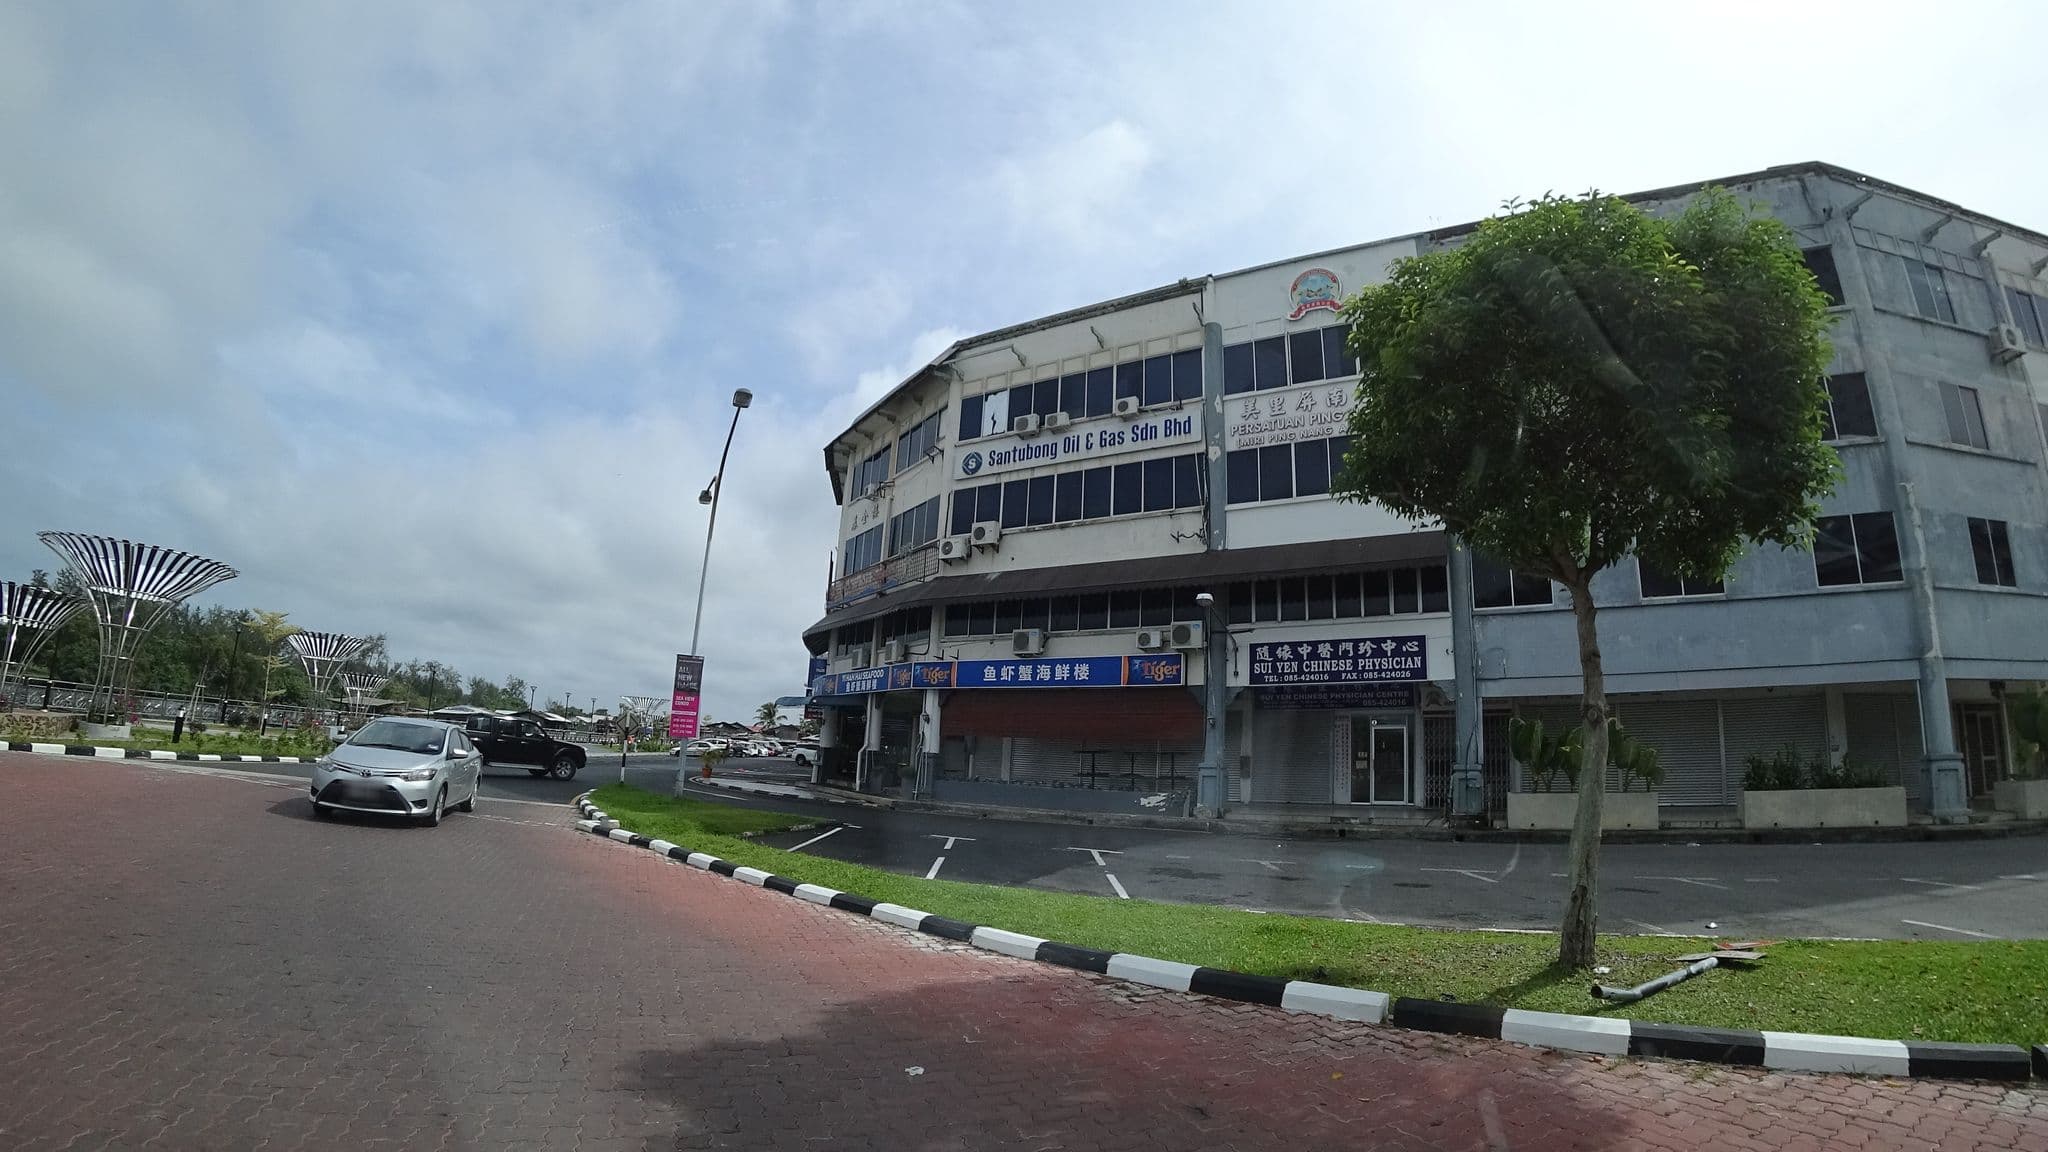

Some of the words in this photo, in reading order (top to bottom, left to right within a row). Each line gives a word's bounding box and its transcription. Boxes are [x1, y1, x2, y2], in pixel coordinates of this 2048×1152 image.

[1231, 416, 1305, 436] PERSATUAN
[1310, 412, 1345, 425] PING
[988, 440, 1058, 467] Santubong
[1063, 434, 1080, 454] Oil
[1100, 430, 1125, 448] Gas
[1131, 423, 1158, 442] Sdn
[1164, 415, 1192, 437] Bhd
[1268, 431, 1296, 443] PING
[1300, 427, 1333, 438] NANG
[863, 669, 885, 679] SEAFOOD
[983, 663, 1090, 682] 鱼虾蟹海鲜楼
[1142, 660, 1180, 682] Tiger
[1254, 662, 1272, 674] SUI
[1276, 661, 1298, 673] YEN
[1303, 659, 1353, 672] CHINESE
[1358, 656, 1422, 670] PHYSICIAN
[921, 667, 950, 685] Tiger
[1284, 673, 1329, 682] 085-424016
[1363, 670, 1411, 679] 085-424026
